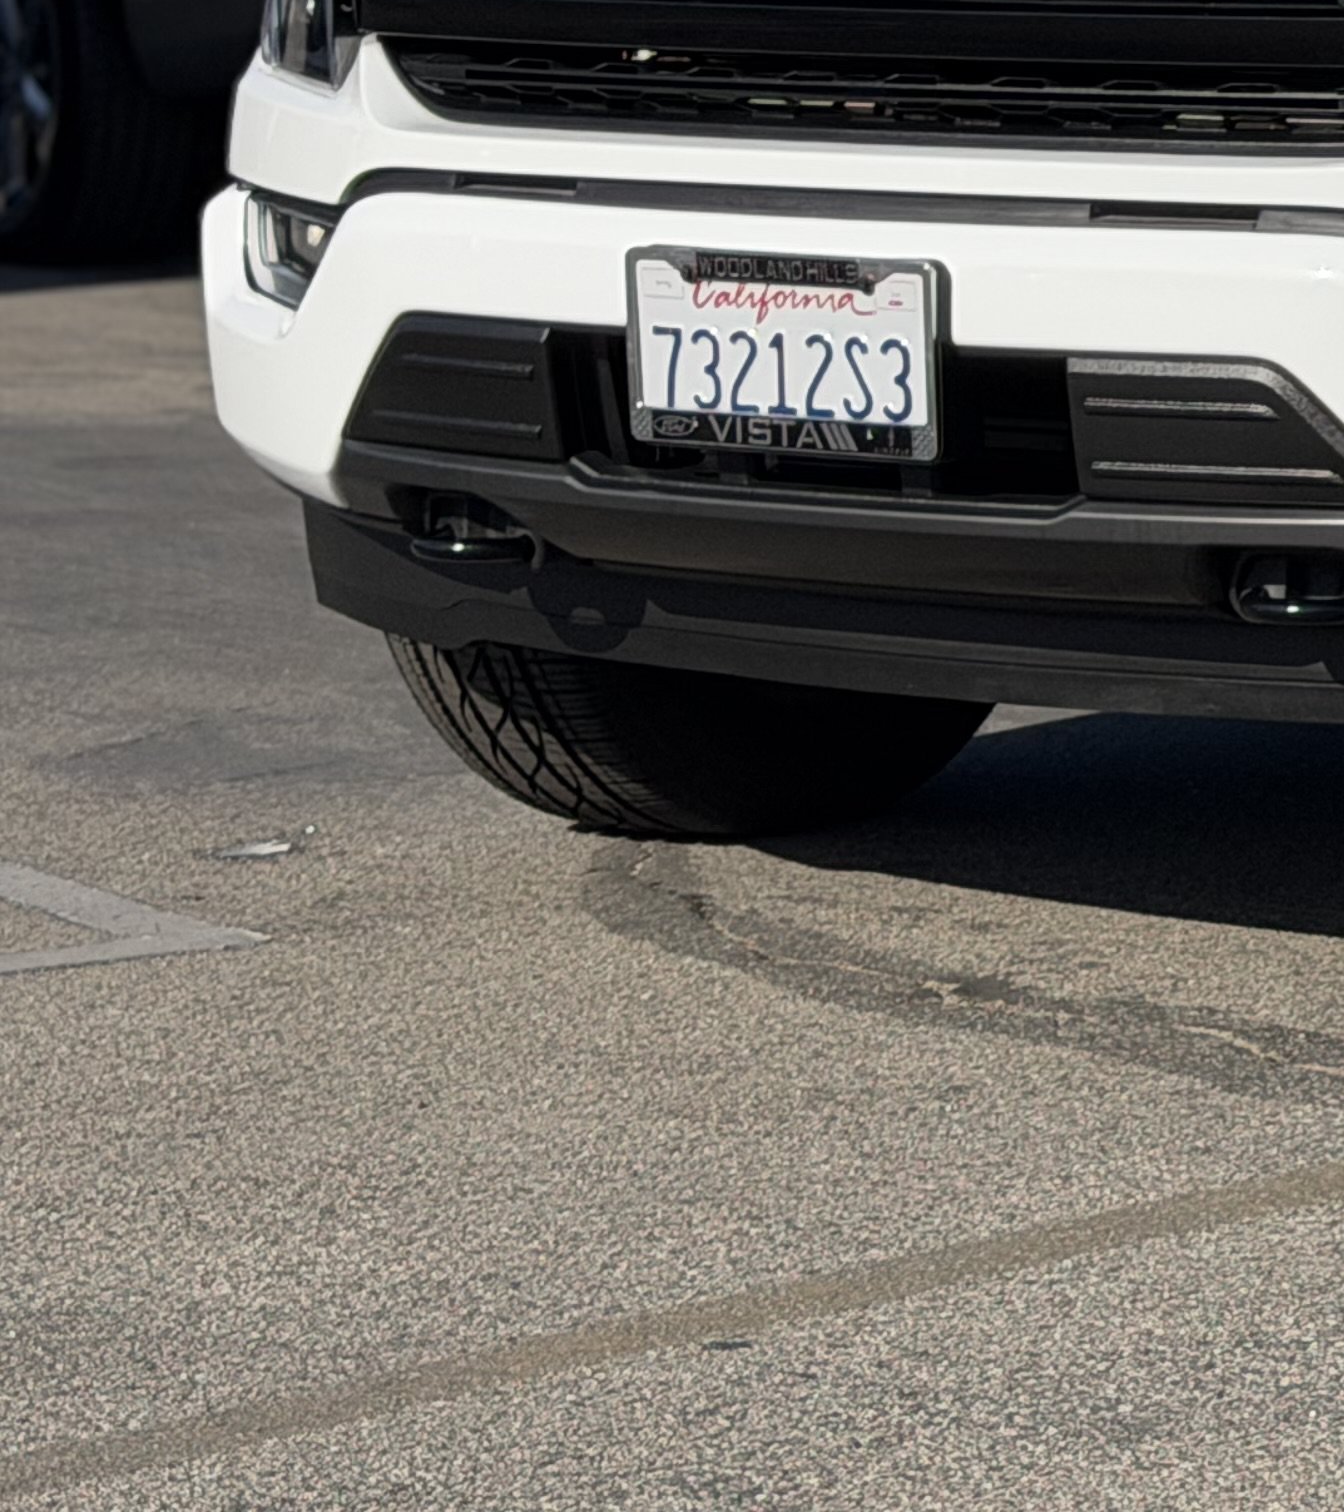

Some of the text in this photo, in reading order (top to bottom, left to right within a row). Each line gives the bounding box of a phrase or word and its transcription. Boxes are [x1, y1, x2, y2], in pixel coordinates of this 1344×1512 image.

[699, 254, 859, 284] WOODLAND HILLS
[692, 280, 877, 325] California
[652, 325, 914, 423] 73212S3
[707, 415, 823, 450] VISTA
